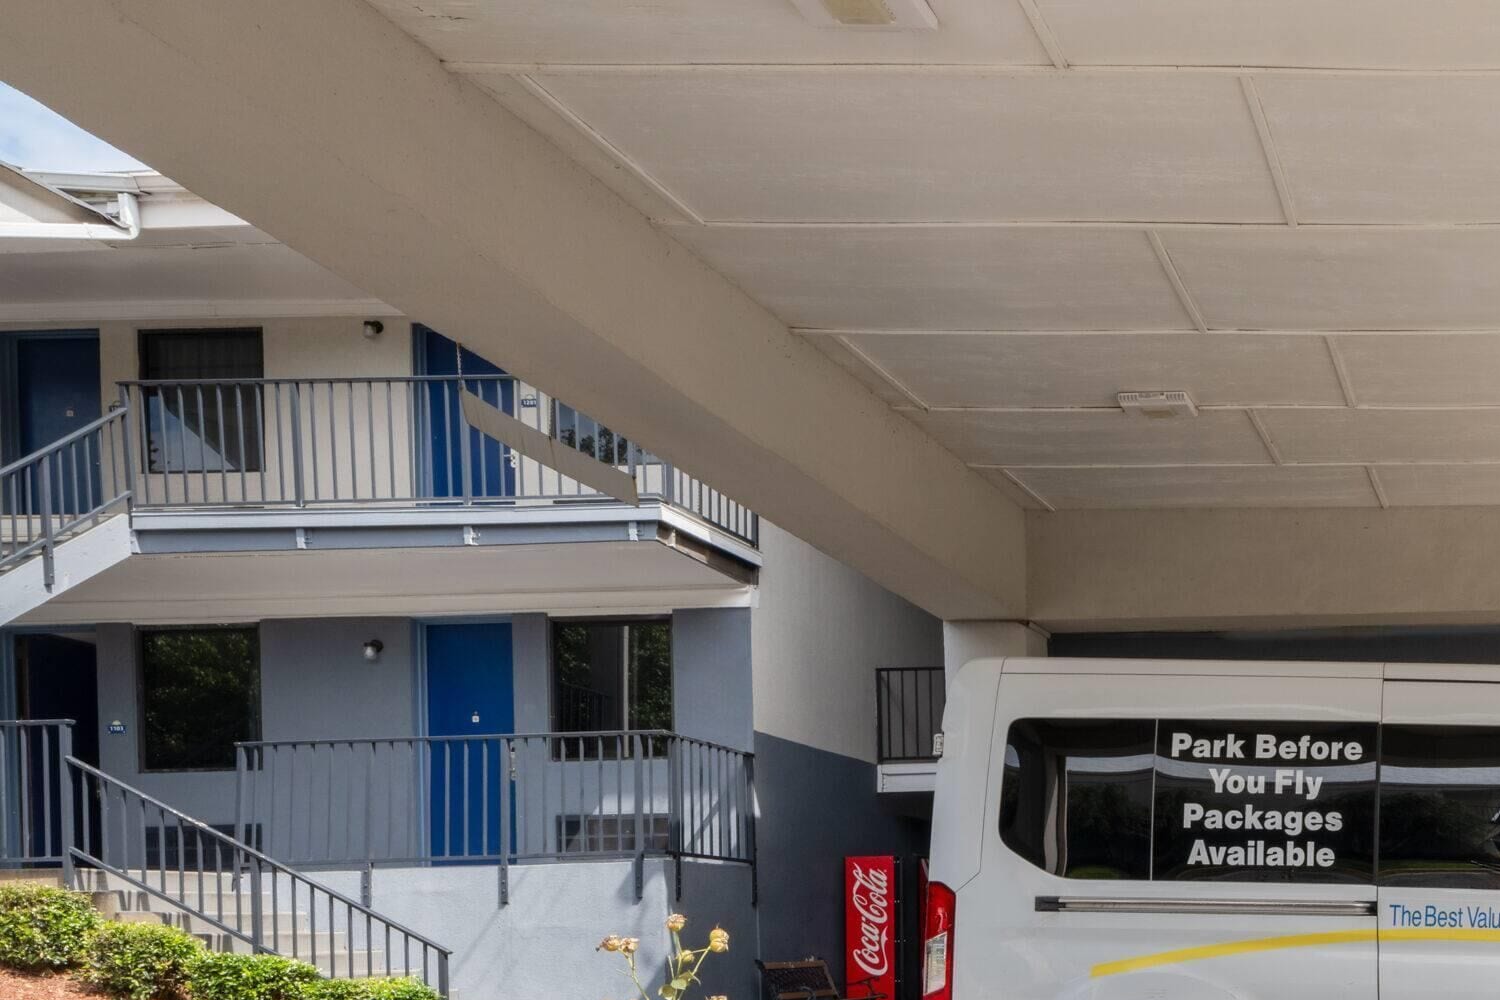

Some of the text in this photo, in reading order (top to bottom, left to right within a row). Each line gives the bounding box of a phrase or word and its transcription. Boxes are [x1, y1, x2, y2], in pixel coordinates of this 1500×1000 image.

[1171, 732, 1363, 761] Park Before
[1208, 768, 1323, 799] You Fly
[1183, 803, 1343, 835] Packages
[1187, 839, 1336, 867] Available
[853, 862, 888, 976] Coca-Cola
[1389, 904, 1422, 927] The
[1425, 905, 1464, 928] Best
